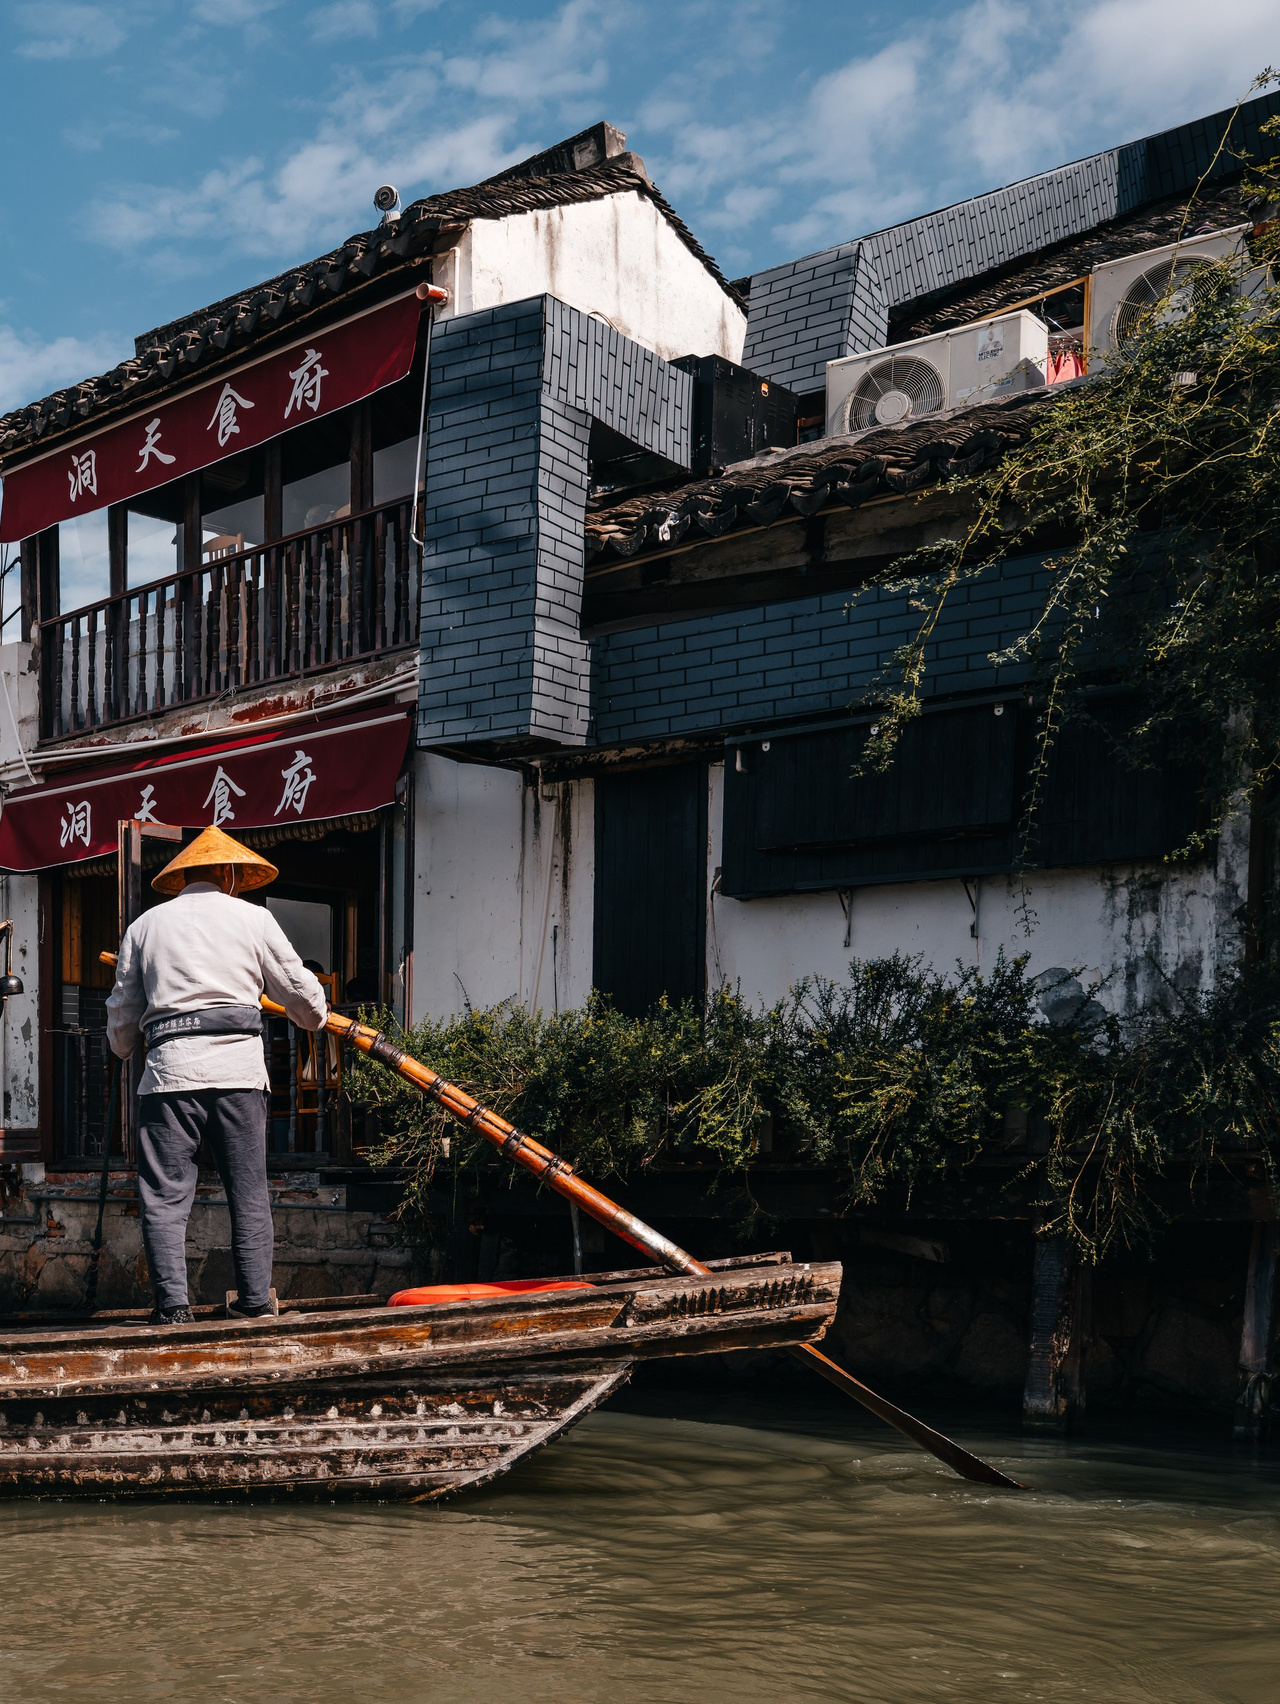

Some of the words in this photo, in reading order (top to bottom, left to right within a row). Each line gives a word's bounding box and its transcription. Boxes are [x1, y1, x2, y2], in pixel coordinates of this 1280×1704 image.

[68, 348, 329, 502] 洞天食府
[60, 750, 317, 848] 洞天食府
